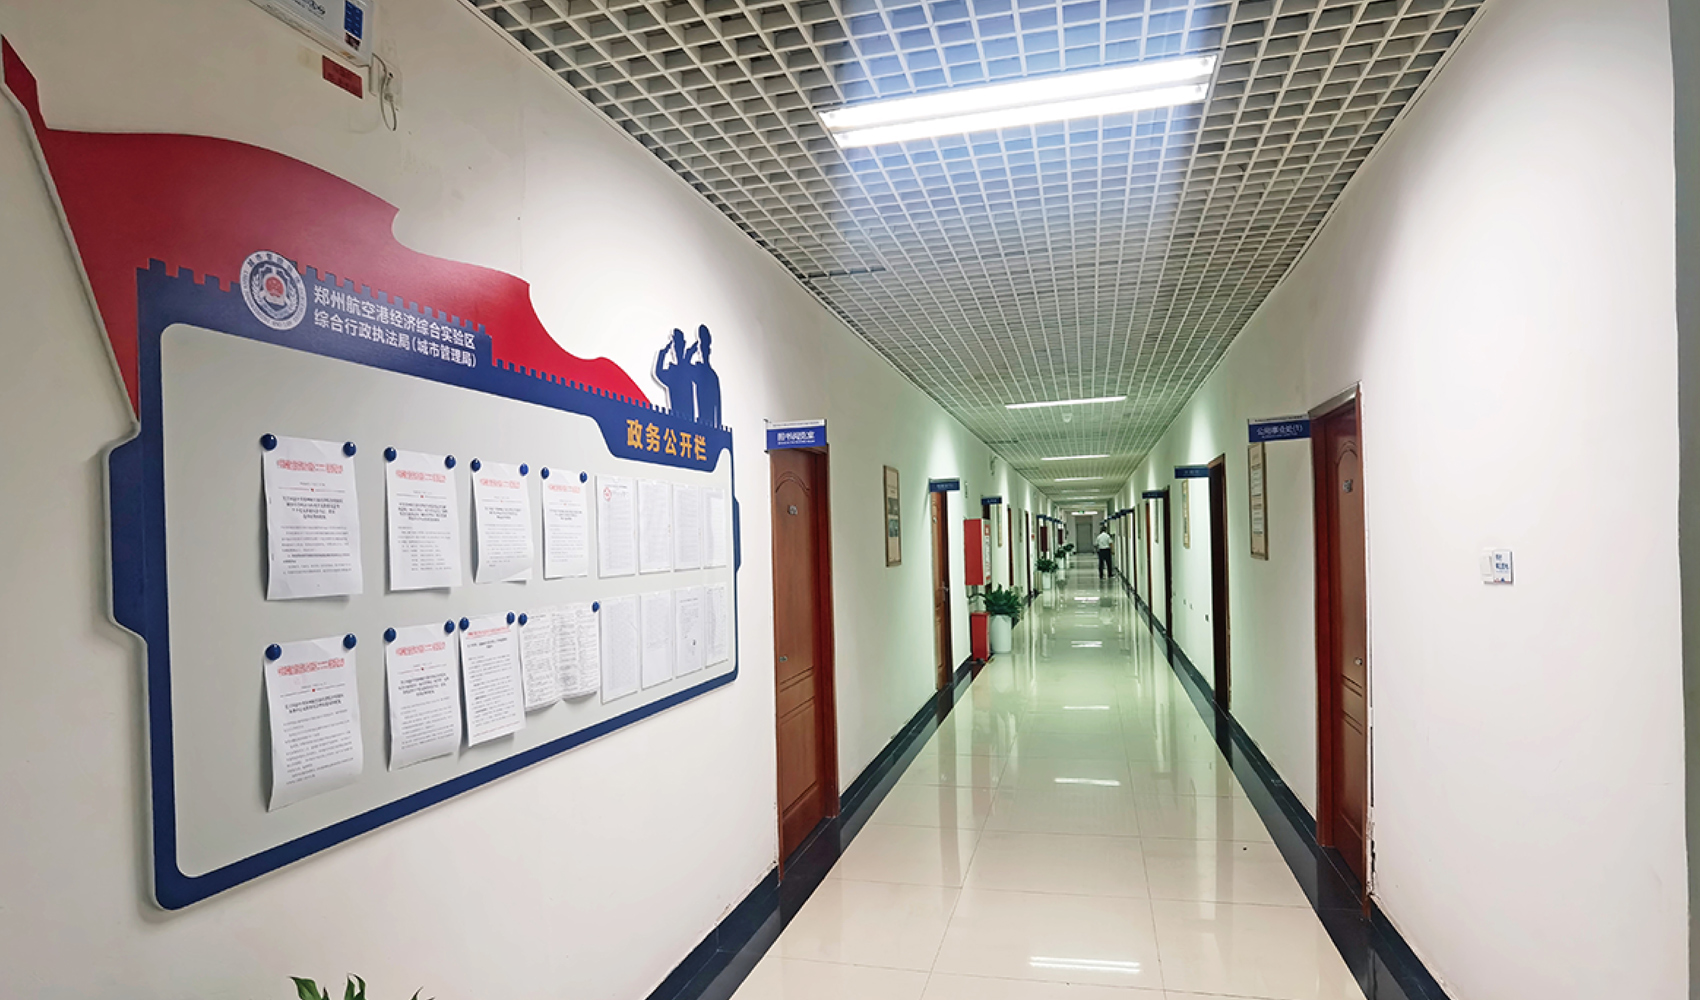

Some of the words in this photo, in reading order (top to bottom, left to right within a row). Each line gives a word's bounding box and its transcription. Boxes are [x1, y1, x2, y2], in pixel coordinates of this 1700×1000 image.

[313, 284, 476, 350] 郑州航空港经济综合实验区
[313, 308, 477, 368] 综合行政执法局(城市管理局)
[626, 419, 708, 461] 政务公开栏
